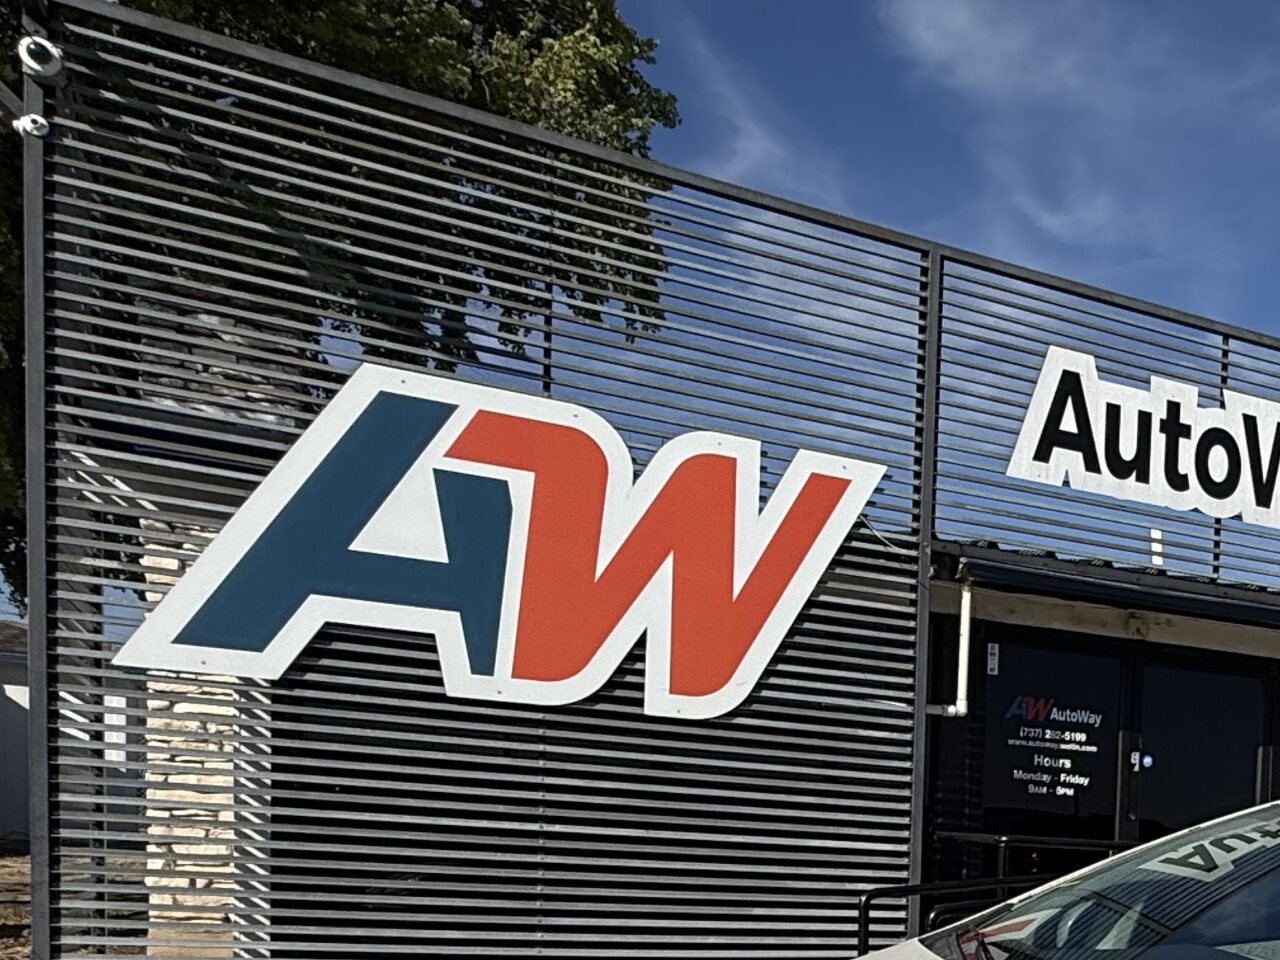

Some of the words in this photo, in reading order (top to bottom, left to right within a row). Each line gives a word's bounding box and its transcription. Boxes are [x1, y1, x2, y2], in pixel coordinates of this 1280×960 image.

[172, 389, 853, 698] AW
[1049, 707, 1103, 728] AutoWay
[1019, 726, 1043, 739] (737)
[1033, 753, 1072, 769] Hours
[1013, 769, 1052, 784] Monday
[1060, 773, 1090, 787] Friday
[1028, 783, 1048, 794] 9AM
